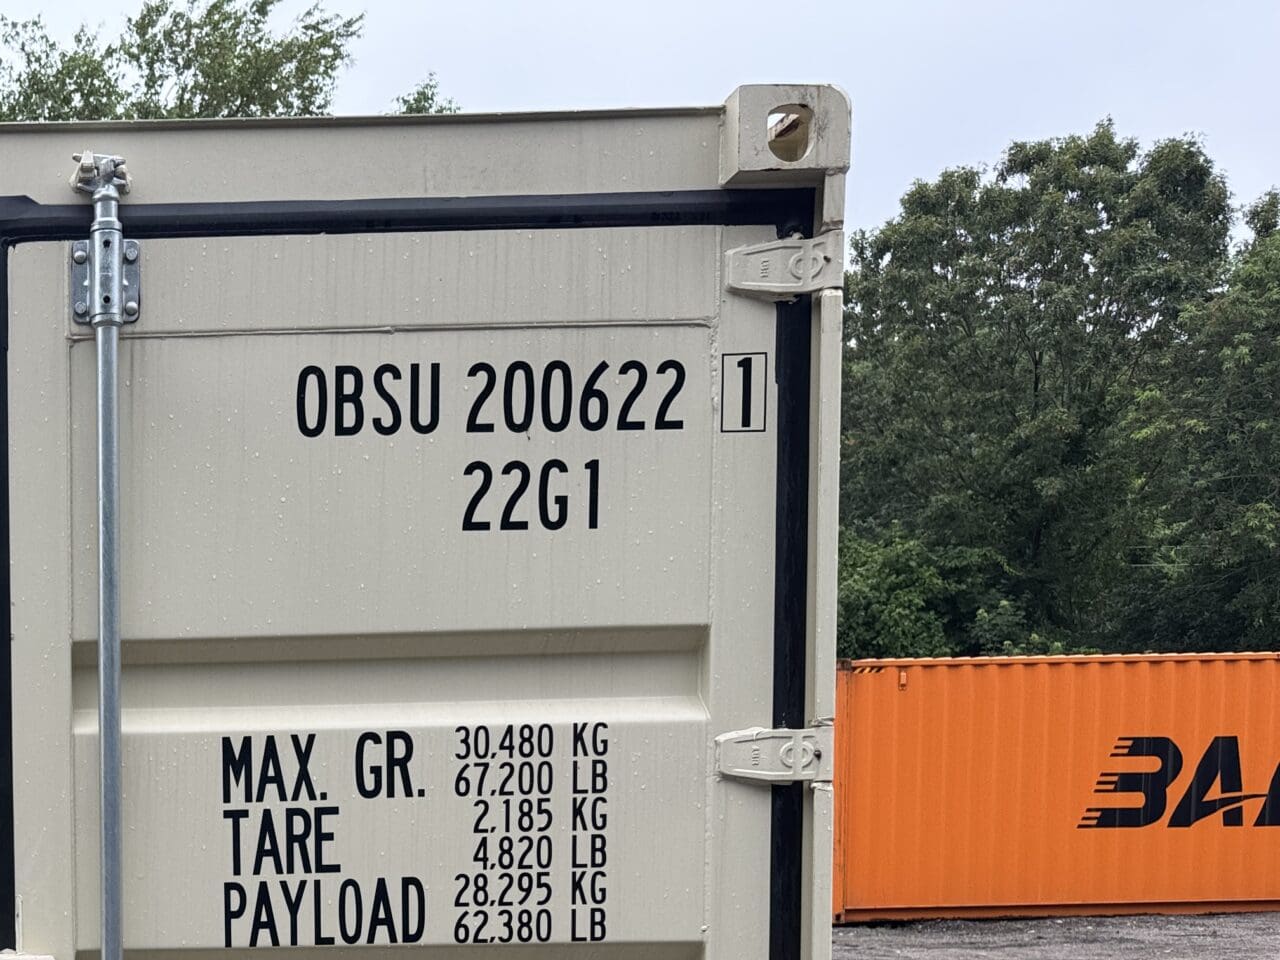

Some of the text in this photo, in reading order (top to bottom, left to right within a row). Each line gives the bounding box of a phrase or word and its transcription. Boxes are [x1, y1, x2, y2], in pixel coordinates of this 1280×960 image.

[297, 356, 754, 438] OBSU 200622 1
[462, 459, 600, 531] 22G1
[455, 722, 609, 759] 30,480 KG
[222, 731, 426, 803] MAX. GR.
[454, 760, 608, 797] 67,200 LB
[473, 797, 608, 834] 2,185 KG
[223, 806, 342, 876] TARE
[473, 834, 607, 870] 4,820 LB
[454, 870, 607, 907] 28,295 KG
[224, 876, 426, 948] PAYLOAD
[454, 907, 607, 944] 62,380 LB
